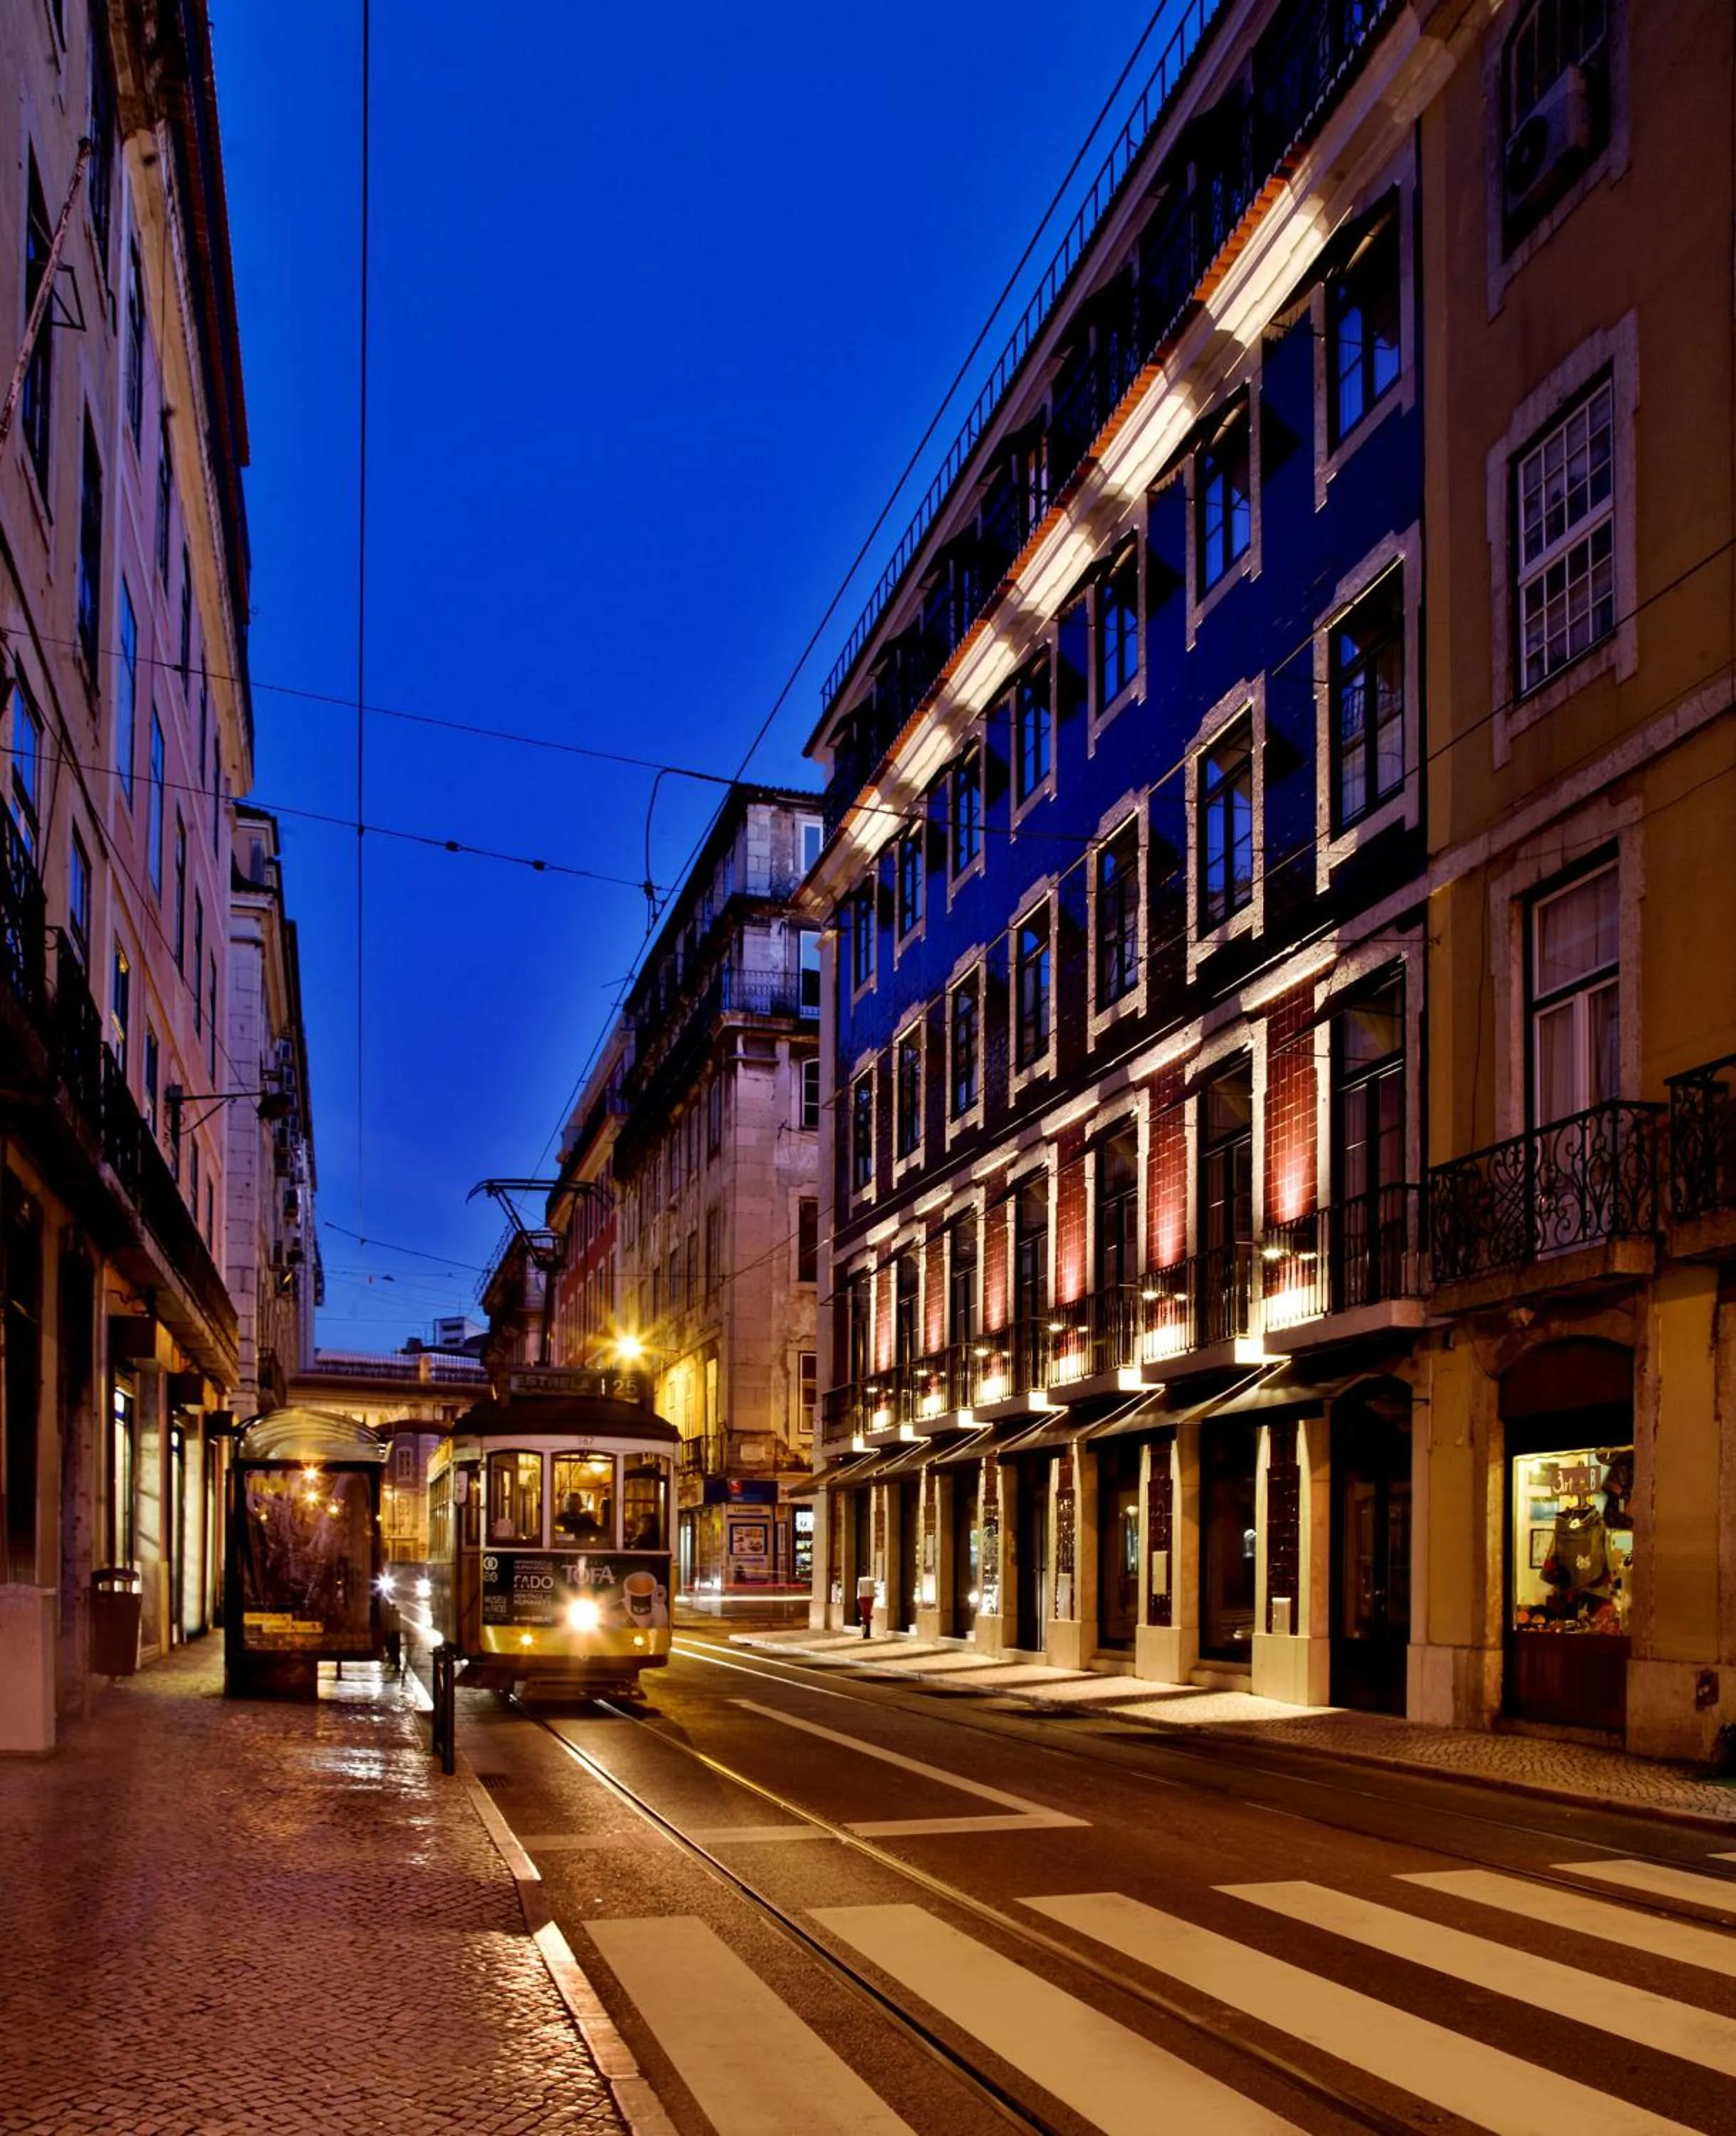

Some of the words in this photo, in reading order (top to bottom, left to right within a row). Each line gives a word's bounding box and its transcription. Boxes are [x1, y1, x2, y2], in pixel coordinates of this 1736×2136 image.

[516, 1374, 591, 1389] ESTRELA
[612, 1379, 638, 1395] 25
[513, 1574, 554, 1589] FADO
[561, 1564, 617, 1584] TOFA
